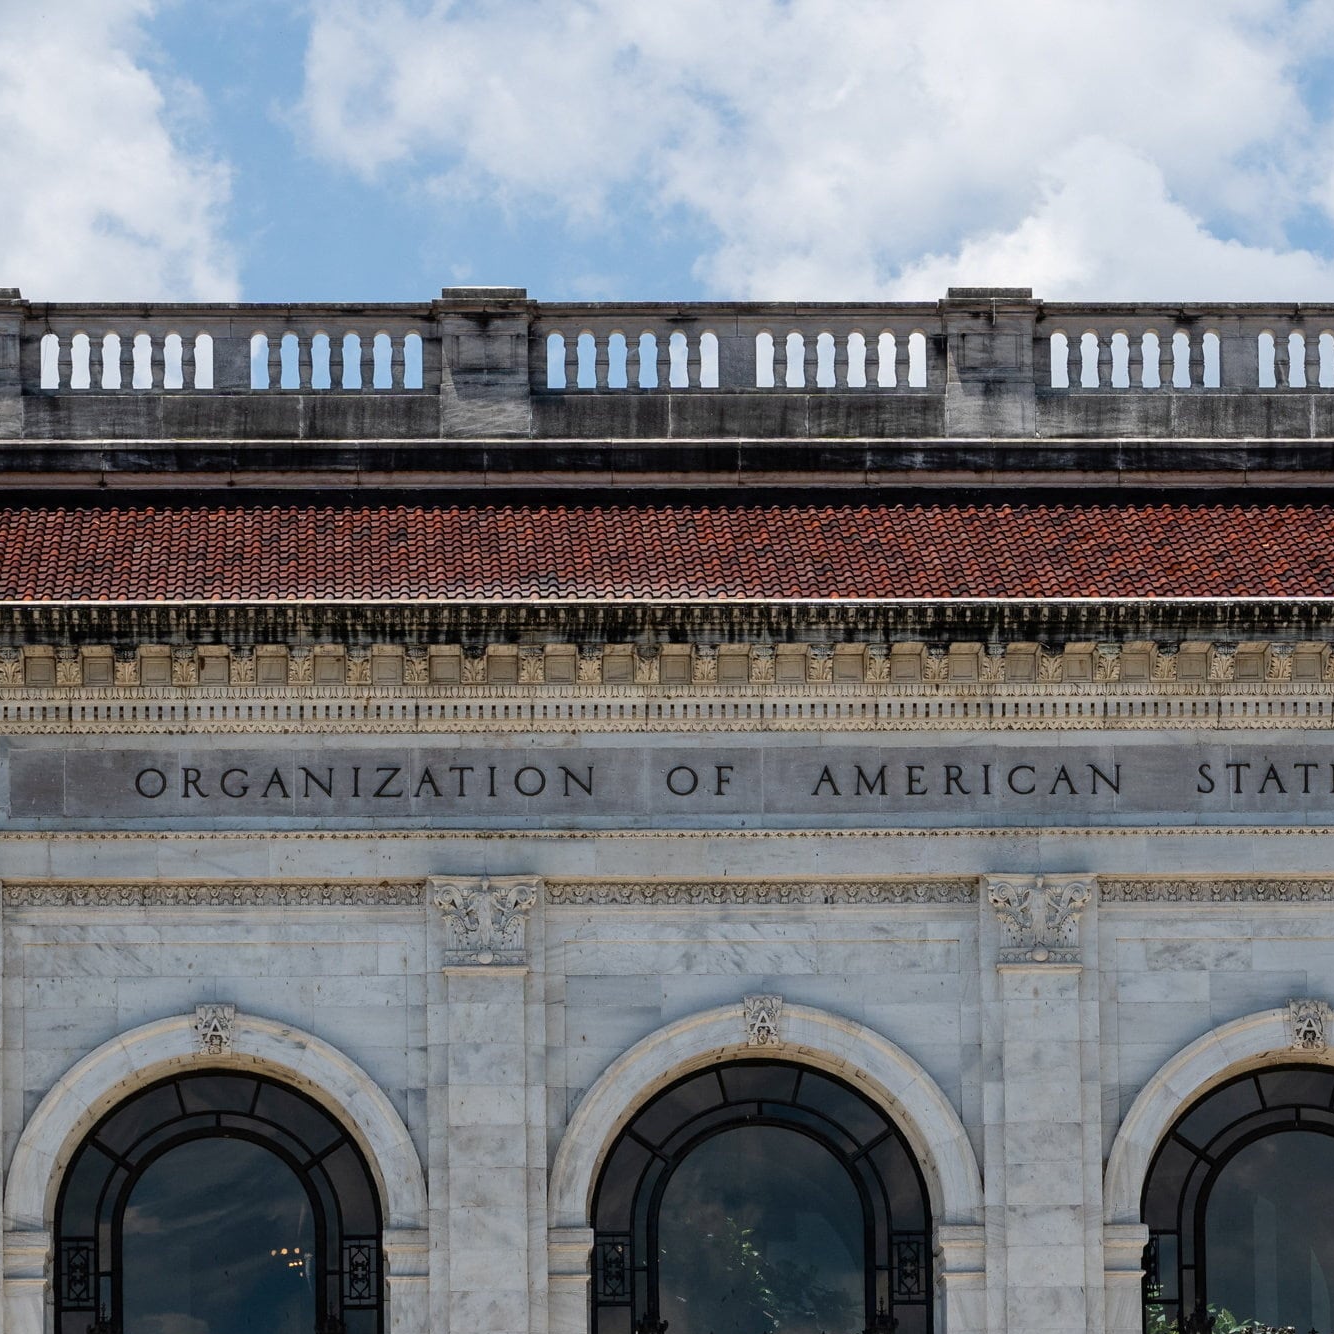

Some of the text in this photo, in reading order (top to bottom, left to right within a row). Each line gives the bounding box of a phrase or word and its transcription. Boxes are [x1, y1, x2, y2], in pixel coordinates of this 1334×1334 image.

[134, 765, 595, 799] ORGANIZATION
[666, 765, 734, 797] OF
[810, 764, 1122, 796] AMERICAN
